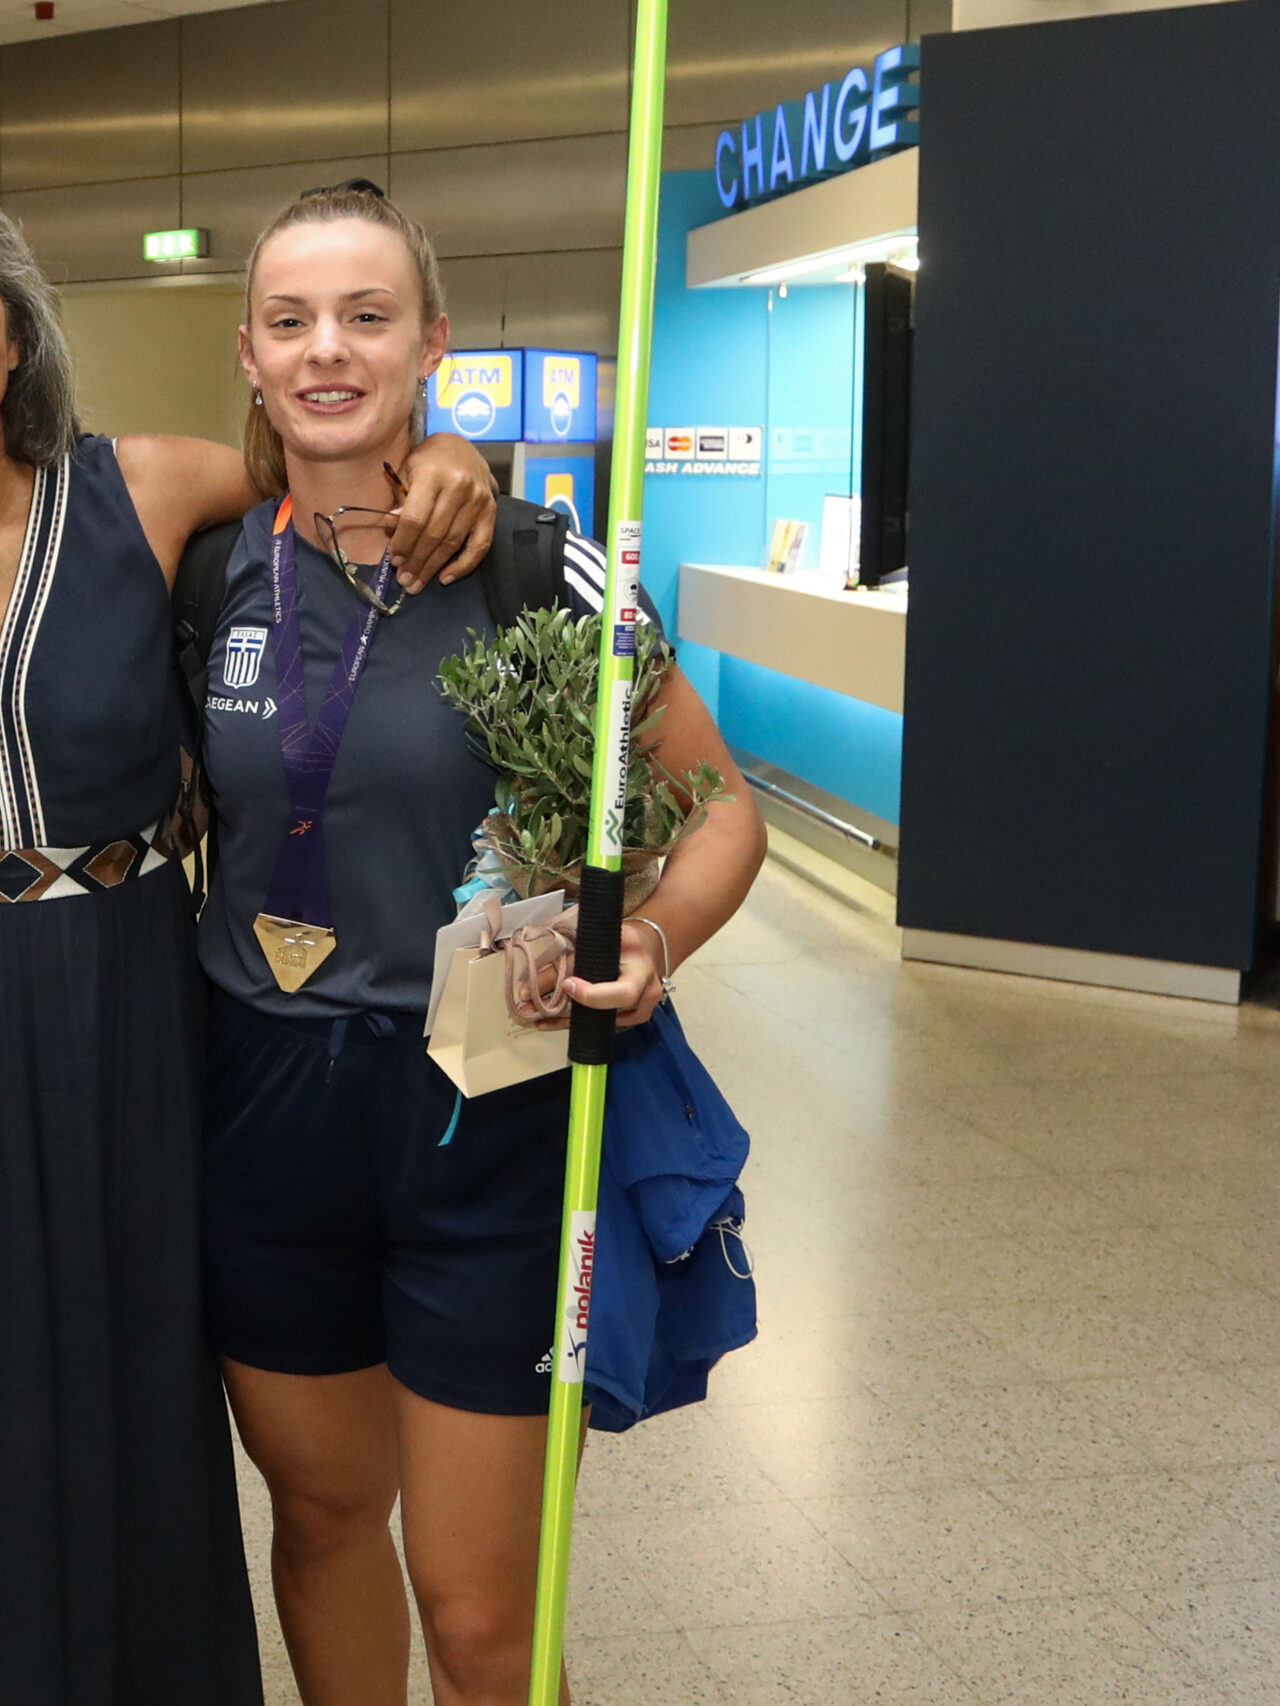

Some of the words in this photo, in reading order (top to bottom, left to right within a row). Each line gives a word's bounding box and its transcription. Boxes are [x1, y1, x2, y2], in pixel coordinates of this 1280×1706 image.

[715, 44, 904, 208] CHANGE
[449, 368, 501, 385] ATM
[551, 369, 574, 385] ATM
[645, 462, 678, 474] ASH
[681, 462, 761, 476] ADVANCE
[274, 584, 282, 624] ATHLETICS
[205, 697, 259, 714] AEGEAN
[615, 687, 633, 810] EuroAthletic
